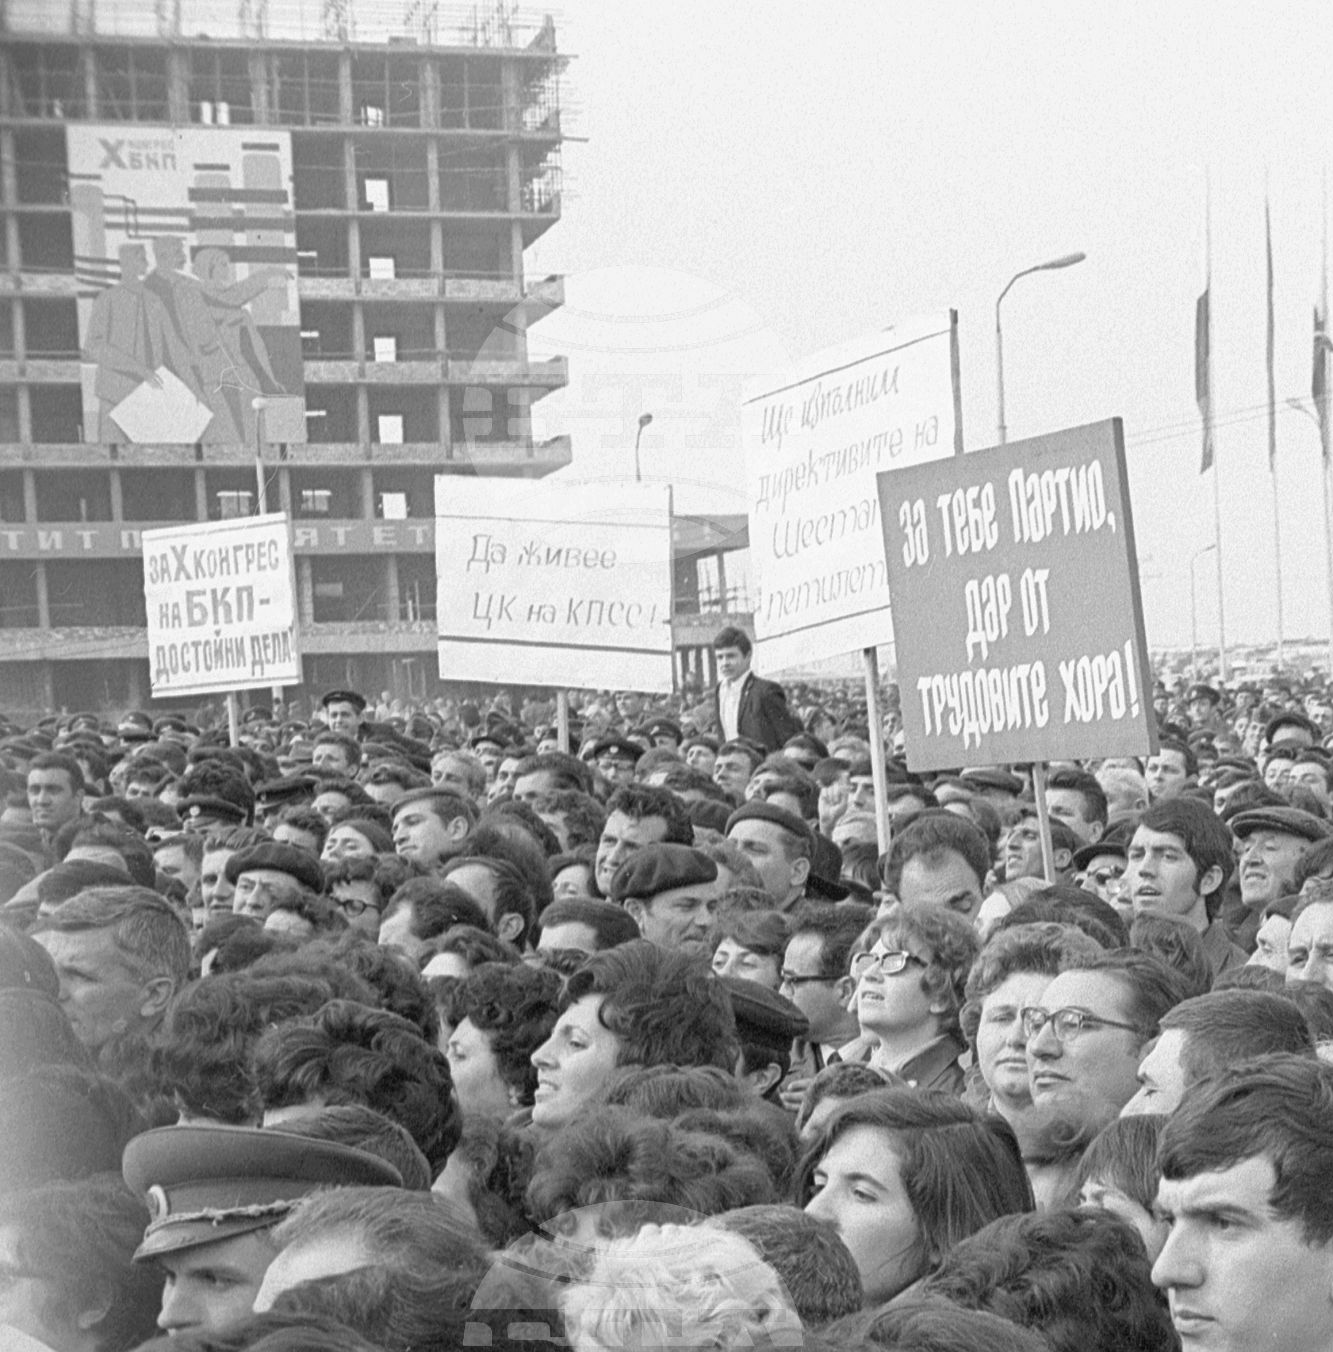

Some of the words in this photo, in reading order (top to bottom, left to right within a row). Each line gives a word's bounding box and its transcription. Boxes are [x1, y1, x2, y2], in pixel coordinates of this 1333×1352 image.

[760, 403, 794, 451] Ще
[754, 426, 904, 516] директивите
[913, 414, 940, 448] на
[772, 498, 878, 560] Шеста
[149, 552, 172, 585] ЗА
[193, 538, 280, 580] КОНГРЕС
[466, 533, 508, 574] Да
[517, 540, 618, 570] живее
[472, 591, 517, 631] ЦК
[526, 603, 557, 624] на
[765, 559, 884, 622] петилет
[158, 601, 183, 629] НА
[155, 628, 247, 684] ДОСТОЙНИ
